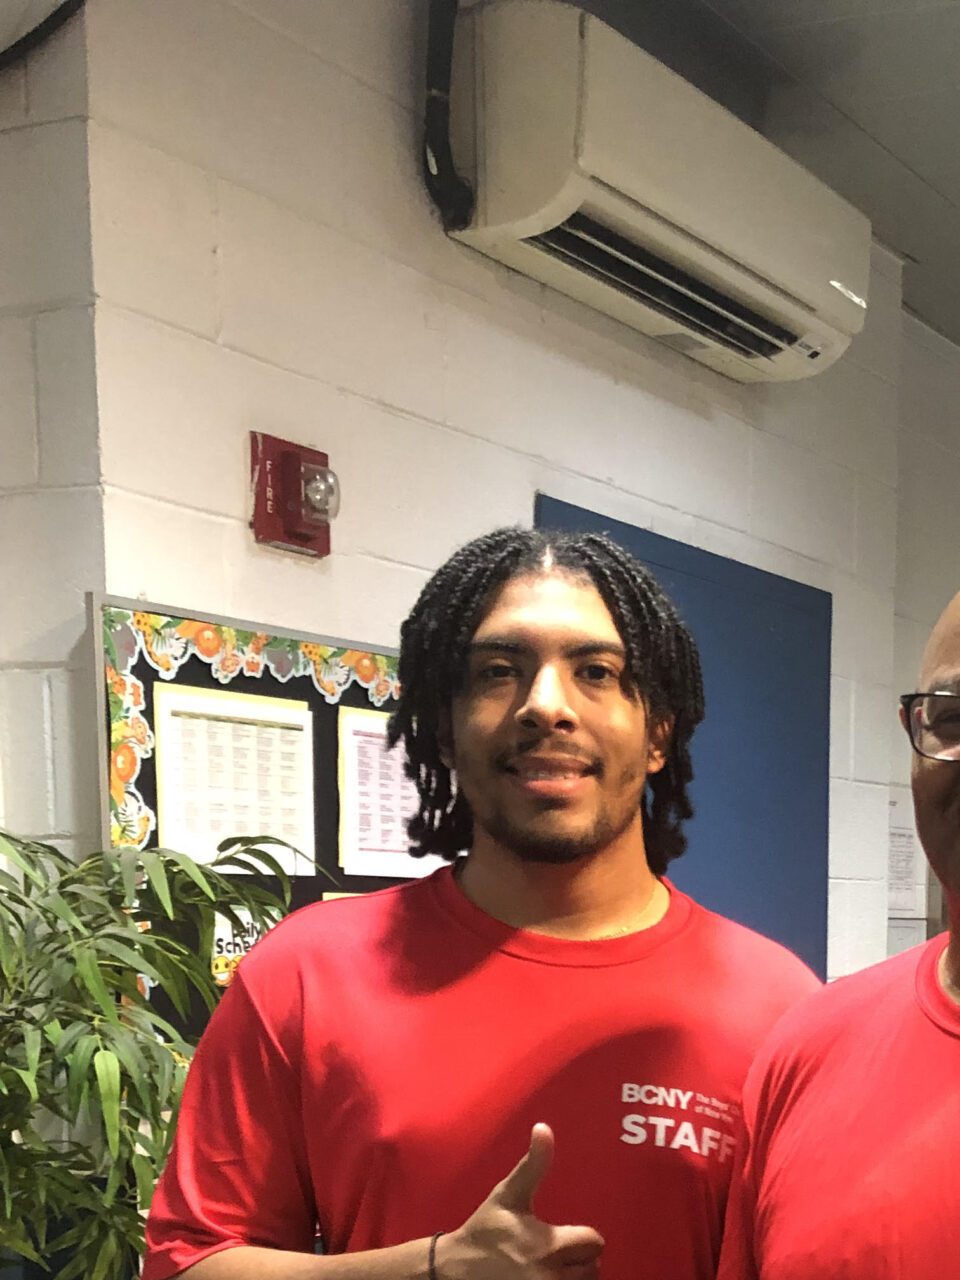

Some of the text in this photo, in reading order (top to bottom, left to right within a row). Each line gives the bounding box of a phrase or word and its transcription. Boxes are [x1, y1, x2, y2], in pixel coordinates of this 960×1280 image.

[265, 460, 273, 514] FIRE
[621, 1083, 694, 1110] BCNY
[619, 1114, 737, 1163] STAFF
